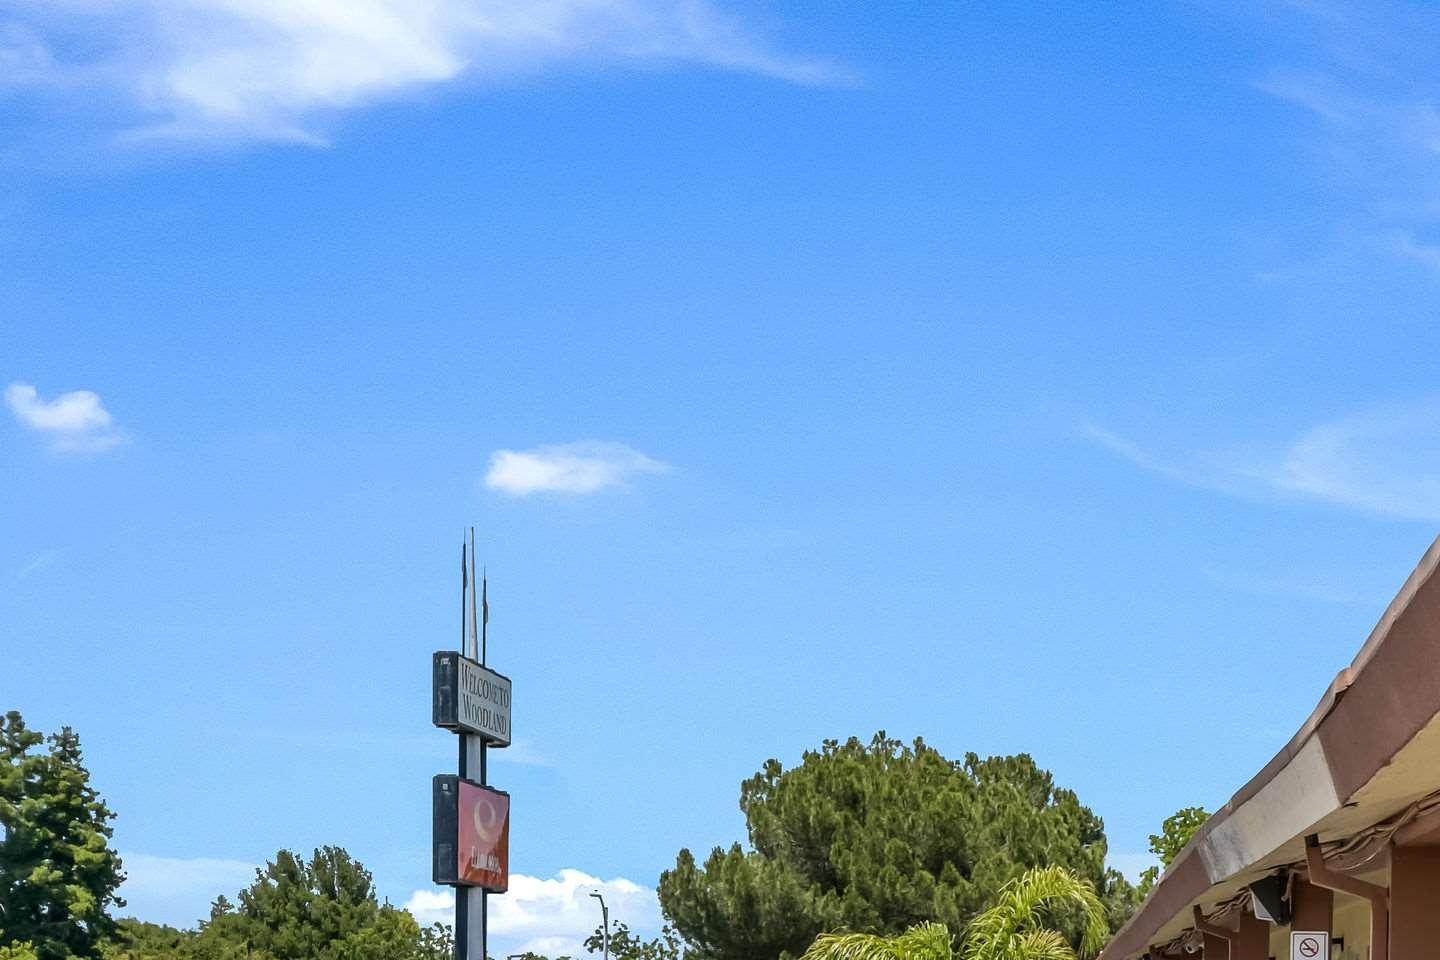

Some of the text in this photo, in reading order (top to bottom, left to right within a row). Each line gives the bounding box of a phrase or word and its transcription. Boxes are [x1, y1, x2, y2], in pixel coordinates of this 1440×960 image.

[461, 662, 509, 708] WELCOME TO
[463, 693, 507, 735] WOODLAND
